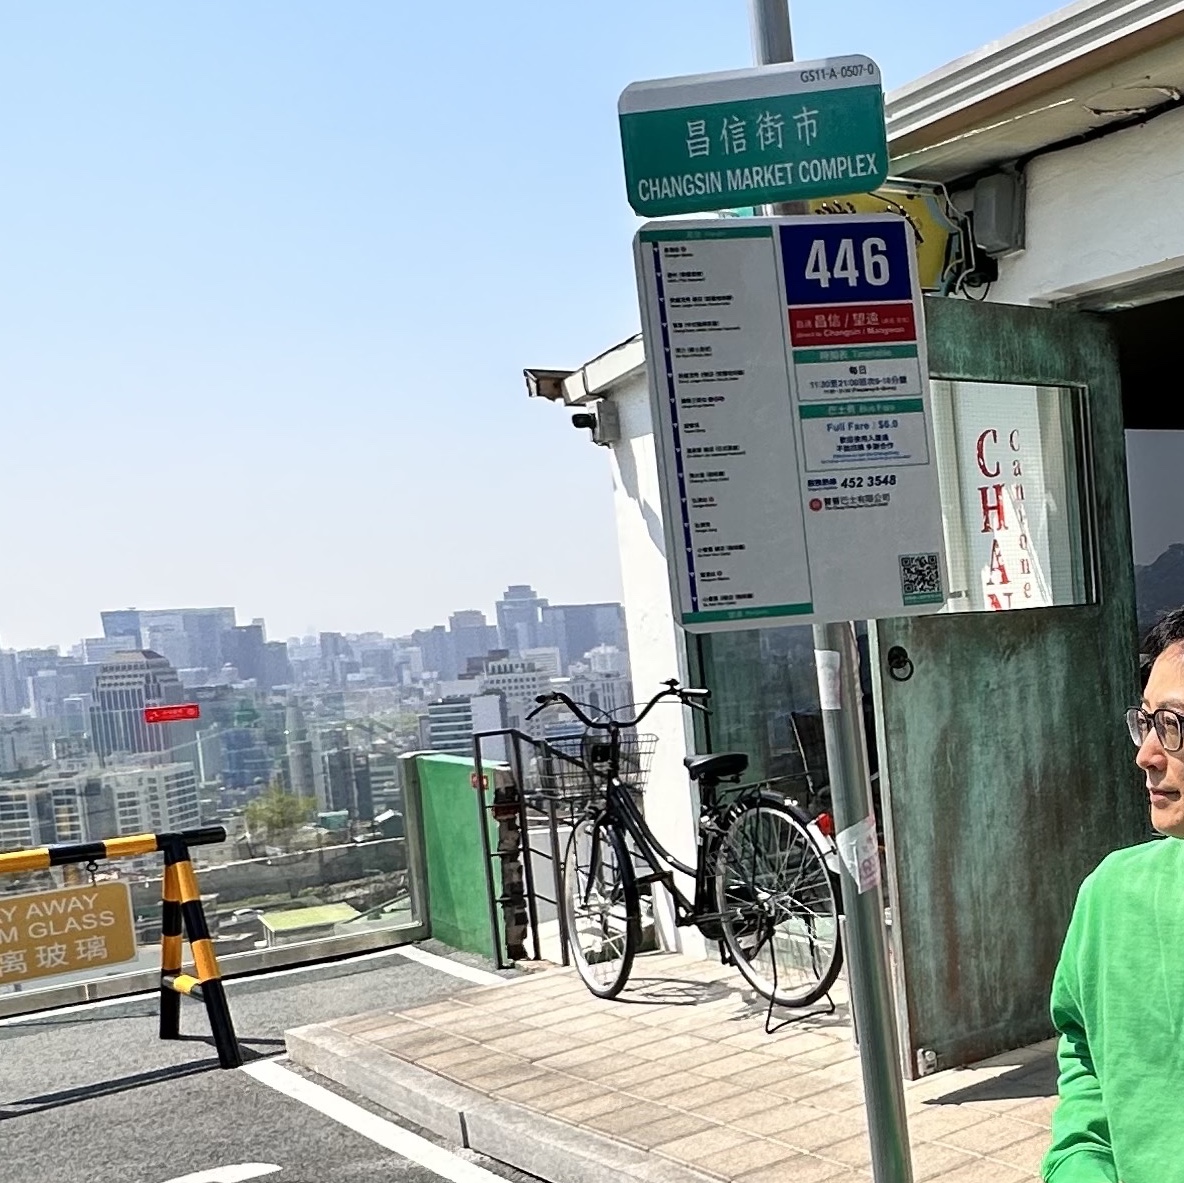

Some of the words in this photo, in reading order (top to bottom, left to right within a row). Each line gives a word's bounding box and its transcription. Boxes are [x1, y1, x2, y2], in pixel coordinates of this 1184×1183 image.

[685, 105, 820, 159] 昌信街市
[638, 171, 722, 202] CHANGSIN
[727, 162, 793, 191] MARKET
[799, 153, 878, 183] COMPLEX
[804, 237, 890, 288] 446
[849, 365, 867, 375] 每日
[826, 422, 845, 432] Full
[847, 421, 870, 431] Fare
[841, 477, 864, 489] 452
[867, 475, 897, 487] 3548
[0, 906, 18, 924] Y
[25, 892, 99, 920] AWAY
[28, 910, 116, 939] GLASS
